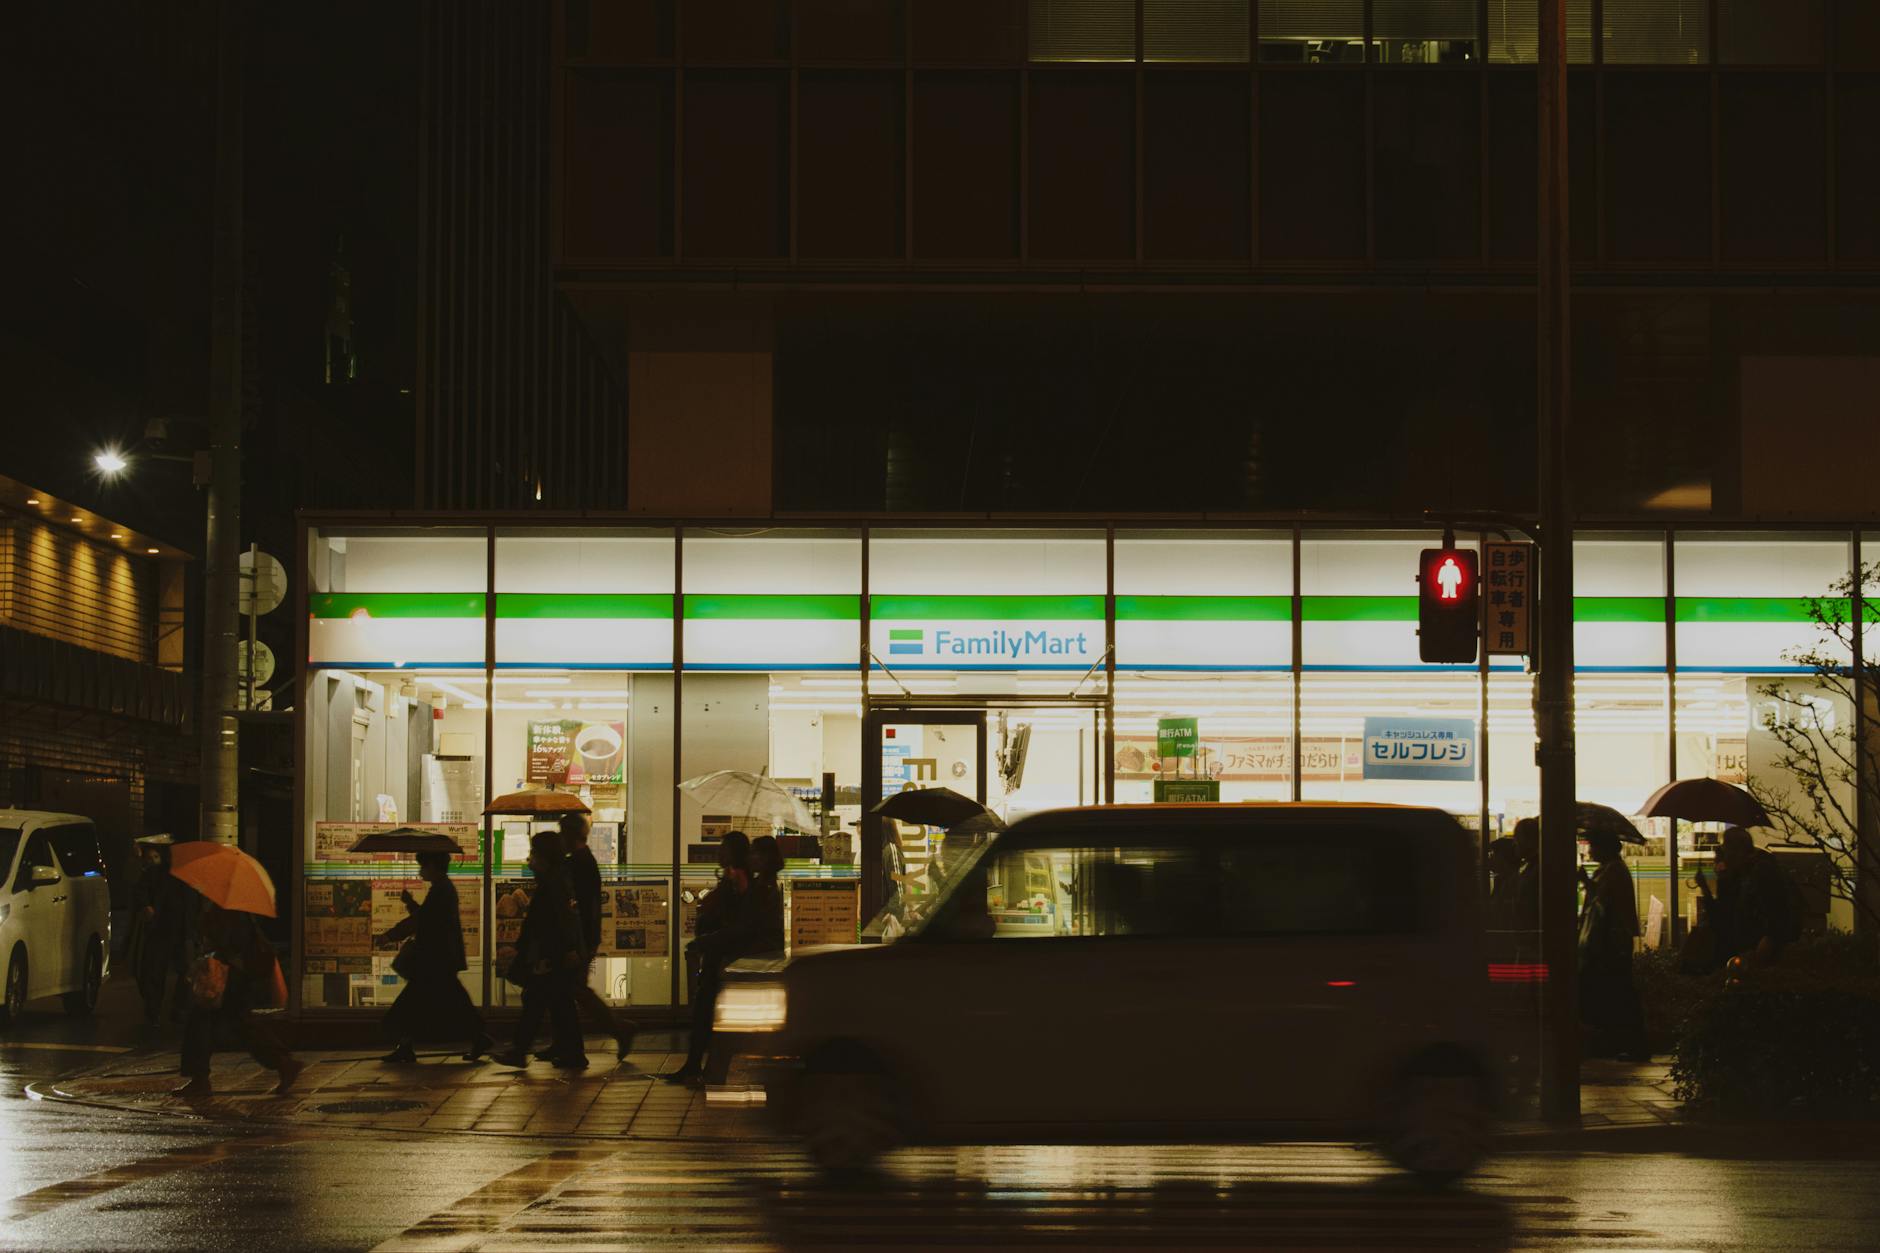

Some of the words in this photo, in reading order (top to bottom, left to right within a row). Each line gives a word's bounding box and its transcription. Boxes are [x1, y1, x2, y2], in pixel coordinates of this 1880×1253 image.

[1489, 549, 1507, 608] 自転車
[1508, 549, 1525, 608] 歩行者
[936, 630, 1087, 658] FamilyMart
[1498, 610, 1516, 648] 専用
[1372, 742, 1467, 760] セルフレジ
[1384, 730, 1454, 739] キャッシュレス専用
